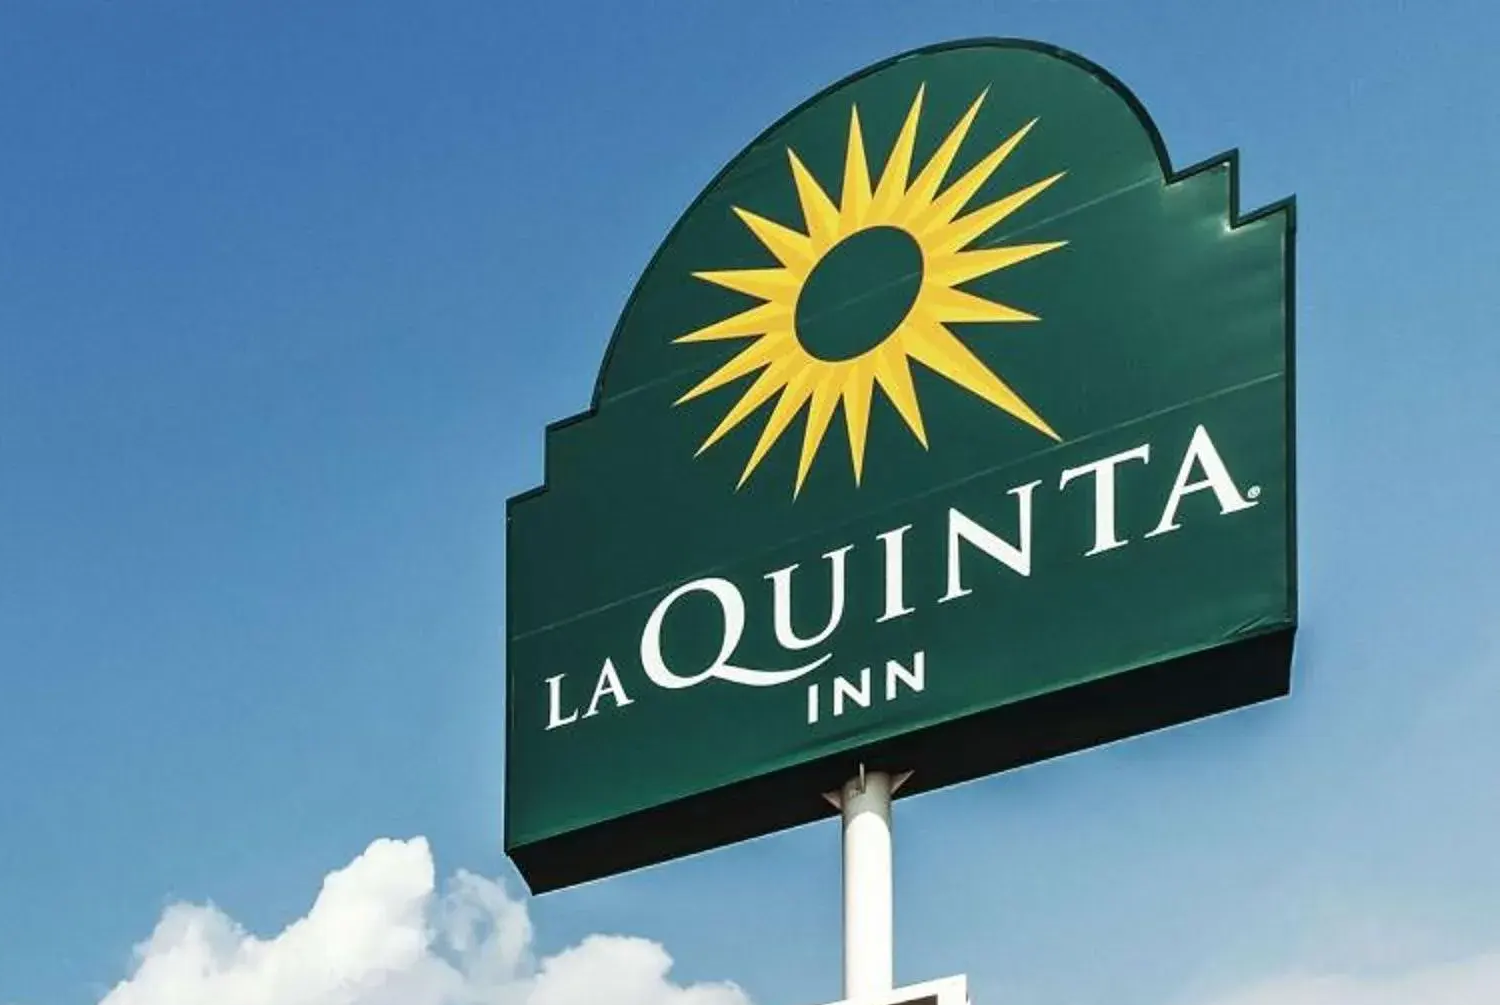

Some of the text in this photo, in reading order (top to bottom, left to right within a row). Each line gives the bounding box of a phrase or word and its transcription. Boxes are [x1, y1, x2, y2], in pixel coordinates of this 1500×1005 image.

[544, 423, 1261, 732] LA QUINTA
[807, 651, 926, 724] INN
